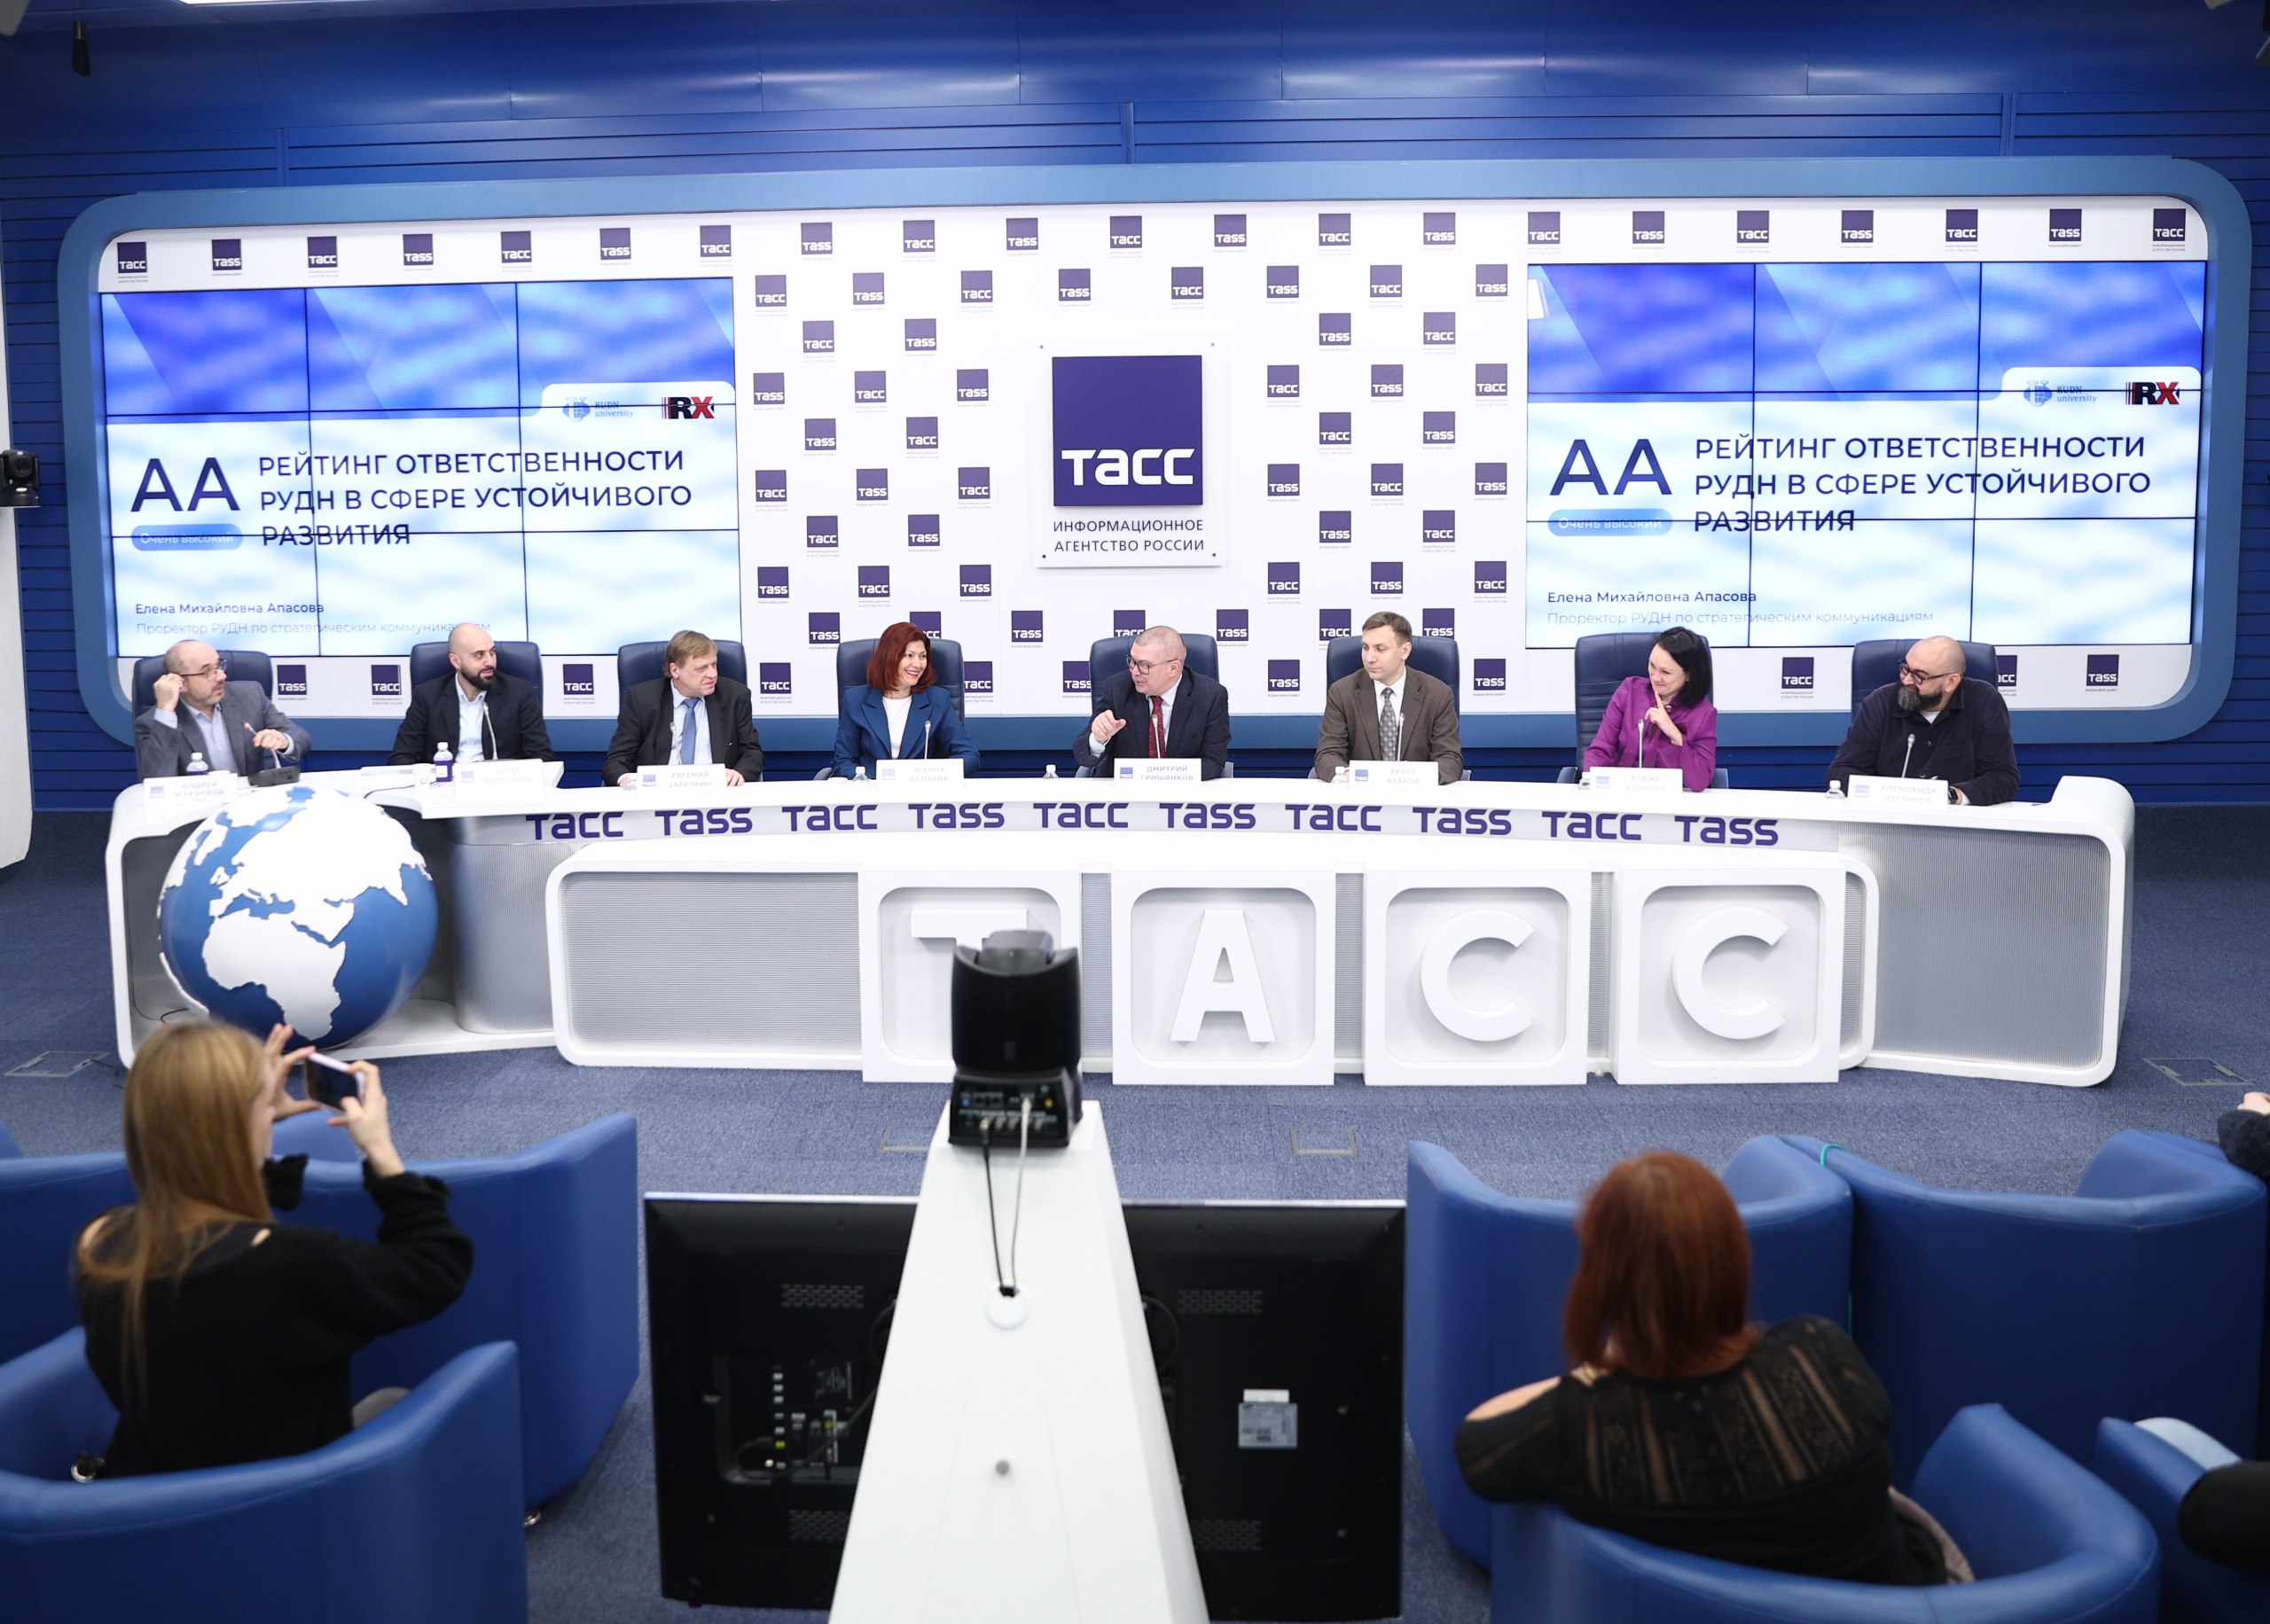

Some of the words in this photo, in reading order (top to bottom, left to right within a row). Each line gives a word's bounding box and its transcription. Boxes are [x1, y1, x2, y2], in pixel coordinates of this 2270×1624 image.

[2056, 394, 2097, 403] university
[595, 409, 634, 418] university
[1696, 433, 1836, 459] РЕЙТИНГ
[1844, 436, 2144, 459] ОТВЕТСТВЕННОСТИ
[259, 451, 387, 476] РЕЙТИНГ
[396, 450, 683, 474] ОТВЕТСТВЕННОСТИ
[1695, 474, 1776, 499] РУДН
[1789, 474, 1805, 495] В
[1815, 473, 1916, 495] СФЕРЕ
[1926, 468, 2151, 495] УСТОЙЧИВОГО
[261, 489, 334, 514] РУДН
[346, 490, 362, 510] В
[371, 488, 466, 510] СФЕРЕ
[474, 482, 692, 508] УСТОЙЧИВОГО
[1053, 519, 1203, 533] ИНФОРМАЦИОННОЕ
[1558, 518, 1600, 529] Очень
[1604, 517, 1662, 529] высокий
[1695, 510, 1855, 532] РАЗВИТИЯ
[140, 532, 179, 544] Очень
[182, 532, 234, 543] высокий
[262, 524, 411, 546] РАЗВИТИЯ
[1054, 540, 1139, 551] АГЕНТСТВО
[1144, 540, 1203, 551] РОССИИ
[1547, 592, 1593, 603] Елена
[1597, 590, 1689, 603] Михайловна
[1694, 591, 1757, 603] Апасова
[136, 604, 176, 614] Елена
[179, 603, 263, 613] Михайловна
[267, 602, 324, 613] Апасова
[1547, 613, 1625, 626] Проректор
[1632, 612, 1671, 624] РУДН
[1676, 614, 1694, 624] по
[1697, 613, 1811, 626] стратегическим
[1816, 612, 1933, 625] коммуникациям
[137, 623, 207, 636] Проректор
[212, 622, 247, 635] РУДН
[270, 623, 376, 636] стратегическим
[380, 622, 490, 636] коммуникам
[1147, 764, 1188, 773] ДМИТРИЙ
